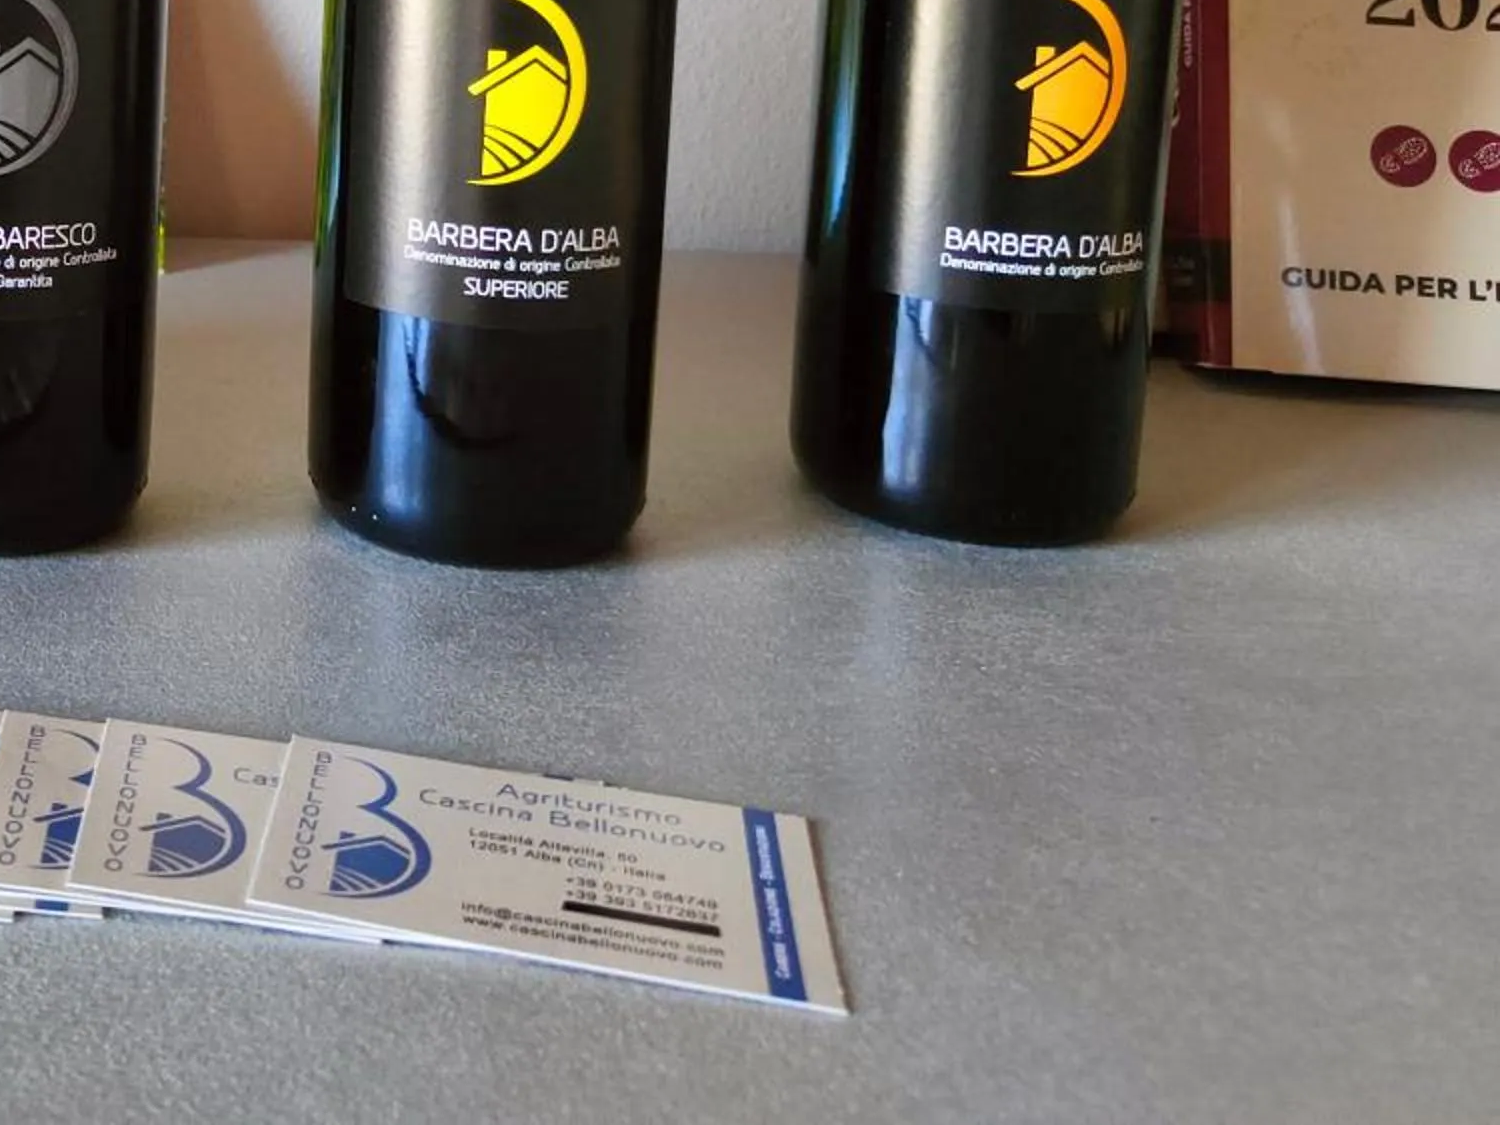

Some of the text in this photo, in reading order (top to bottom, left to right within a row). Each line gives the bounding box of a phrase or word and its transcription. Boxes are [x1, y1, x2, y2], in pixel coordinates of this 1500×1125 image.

[406, 217, 621, 254] BARBERA D'ALBA
[944, 225, 1144, 258] BARBERA D'ALBA
[3, 254, 15, 269] di
[19, 253, 60, 272] origine
[403, 244, 501, 271] Denominazione
[503, 256, 516, 271] di
[519, 256, 561, 275] origine
[940, 251, 1041, 277] Denominazione
[1044, 261, 1056, 277] di
[1059, 262, 1097, 280] origine
[463, 276, 570, 299] SUPERIORE
[1280, 266, 1500, 302] GUIDA PER L'
[103, 733, 148, 873] BELLONUOVO
[496, 782, 682, 826] Agriturismo
[285, 751, 333, 891] BELLONUOVO
[418, 787, 727, 854] Cascina Bellonuovo
[469, 839, 518, 856] 12051
[524, 849, 562, 864] Alba
